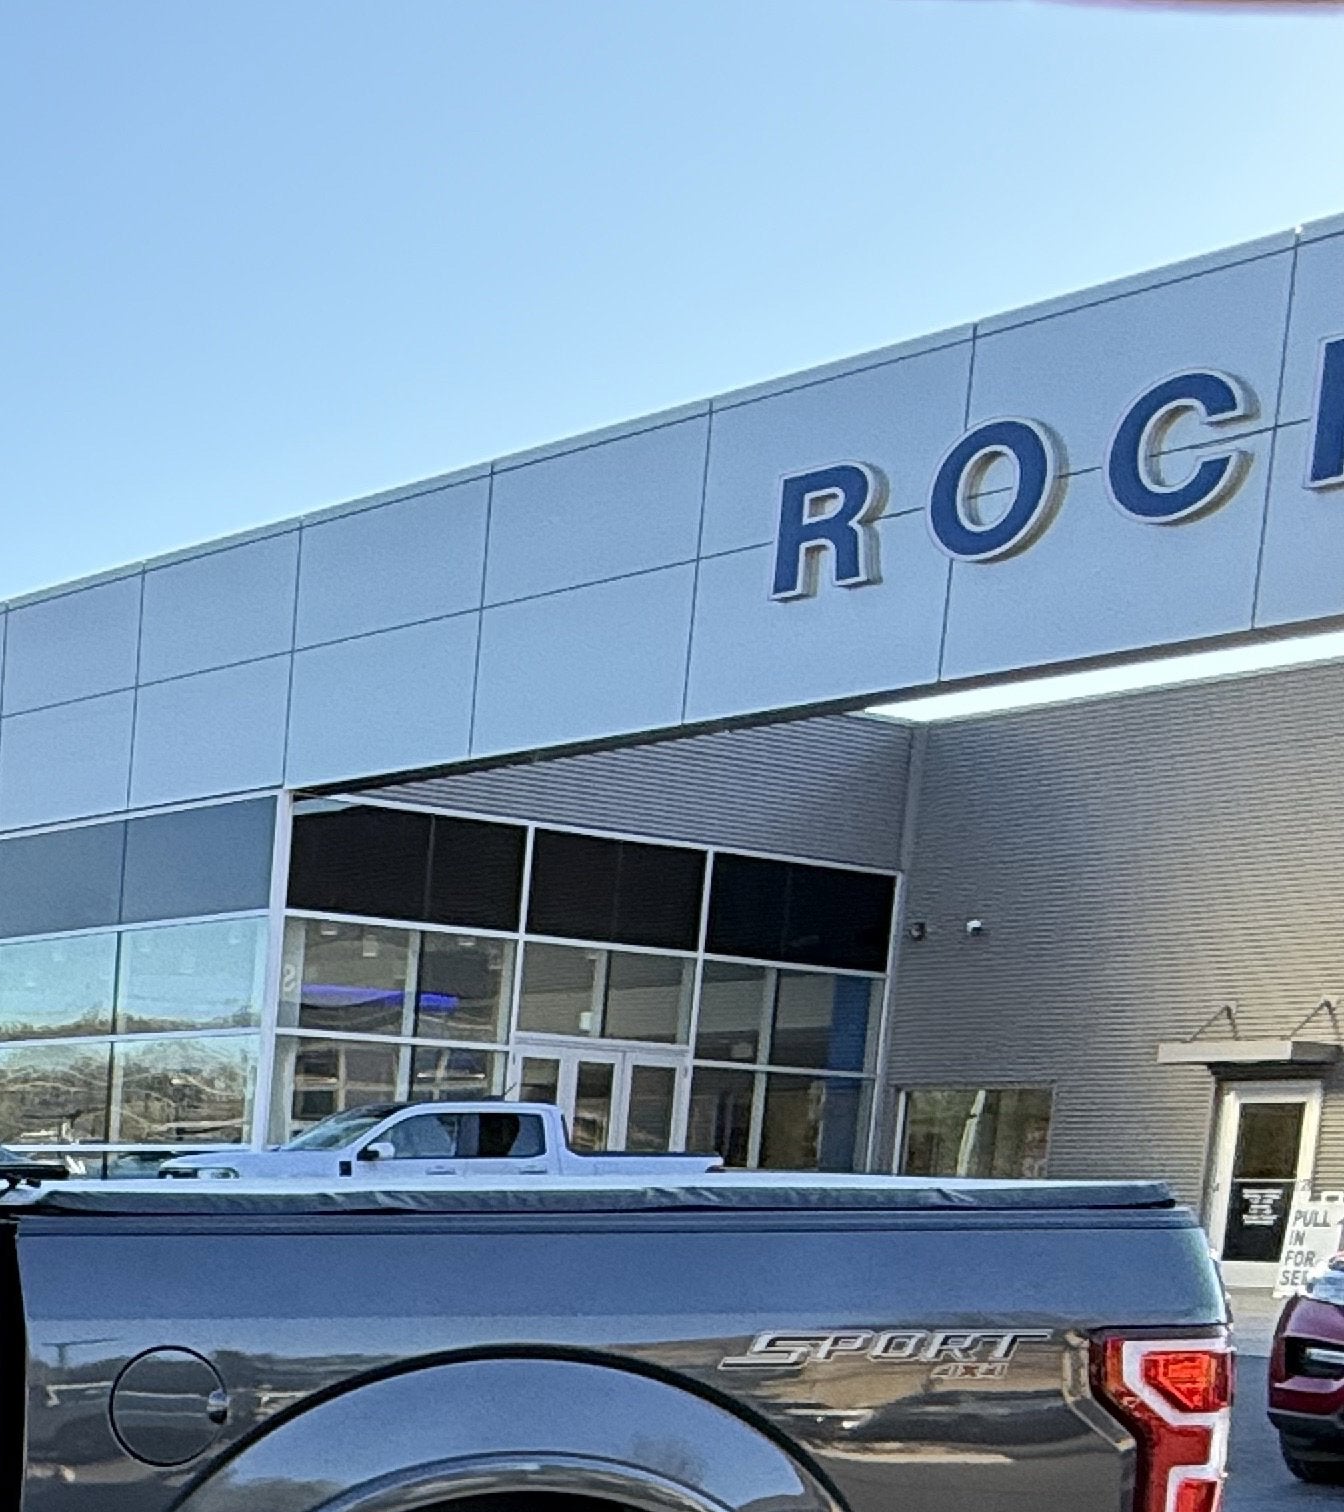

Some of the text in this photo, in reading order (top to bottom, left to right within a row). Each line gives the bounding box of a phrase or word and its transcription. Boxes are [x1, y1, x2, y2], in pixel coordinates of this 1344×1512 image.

[1292, 1208, 1331, 1228] PULL
[1288, 1230, 1306, 1246] IN
[1284, 1250, 1316, 1268] FOR
[717, 1329, 1054, 1369] SPORT
